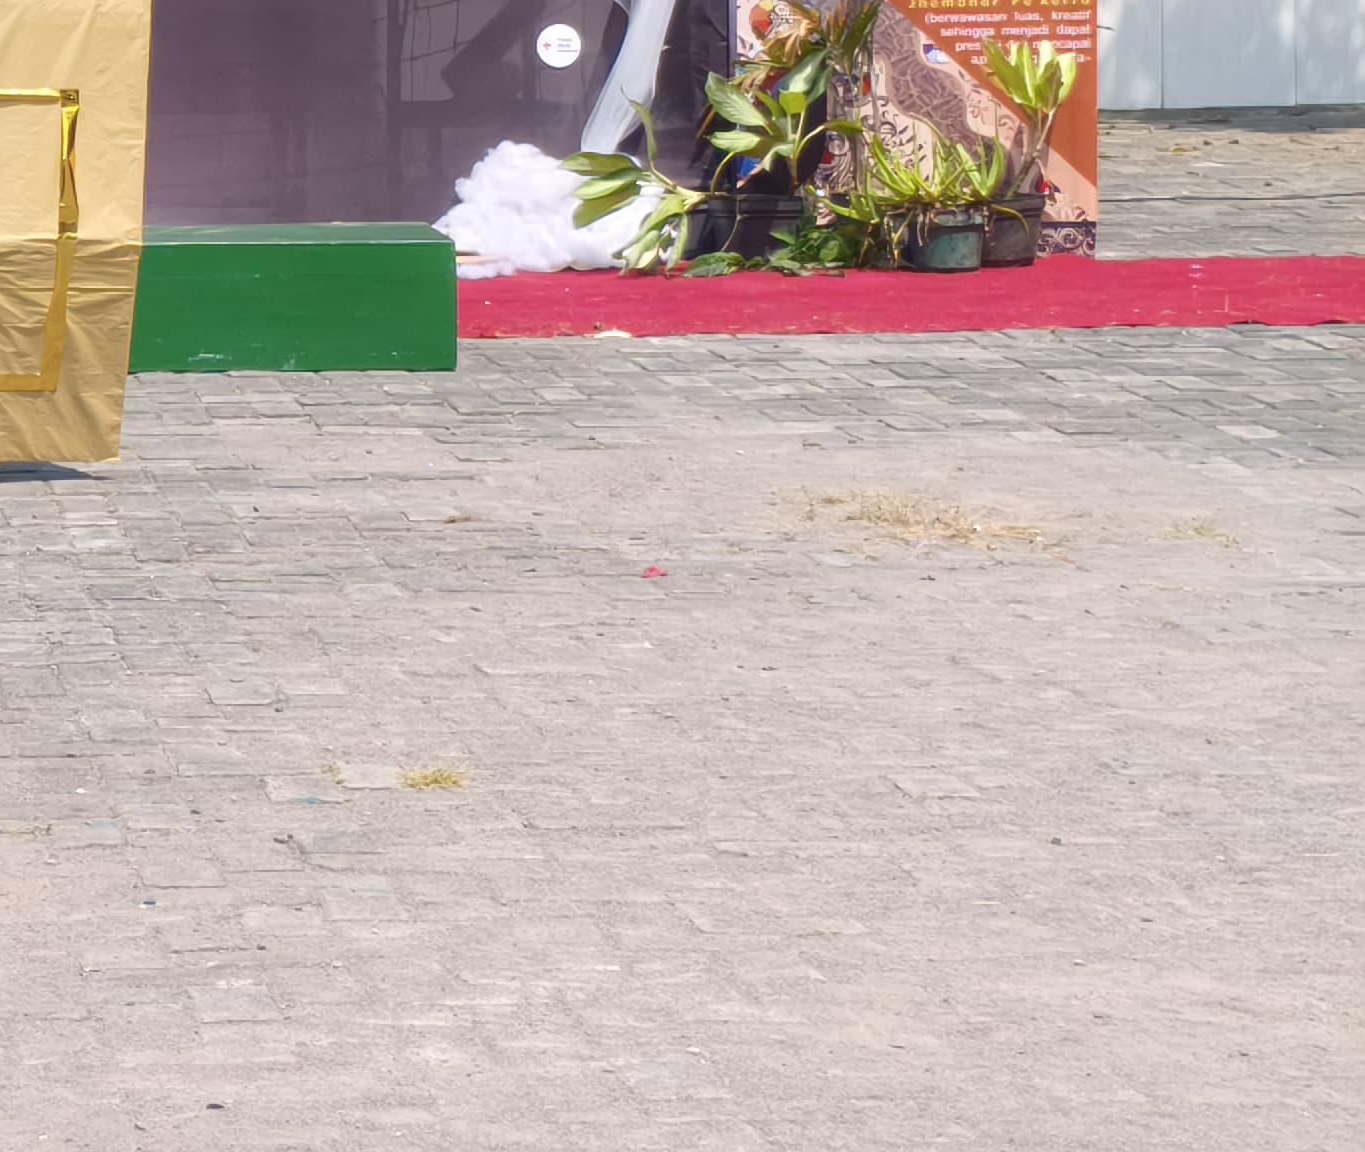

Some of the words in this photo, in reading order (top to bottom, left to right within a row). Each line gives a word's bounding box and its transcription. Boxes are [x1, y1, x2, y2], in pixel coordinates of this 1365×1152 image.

[1051, 9, 1091, 21] kreatif
[940, 26, 995, 38] sehingga
[1001, 24, 1050, 38] menjadi
[1056, 24, 1090, 36] dapat
